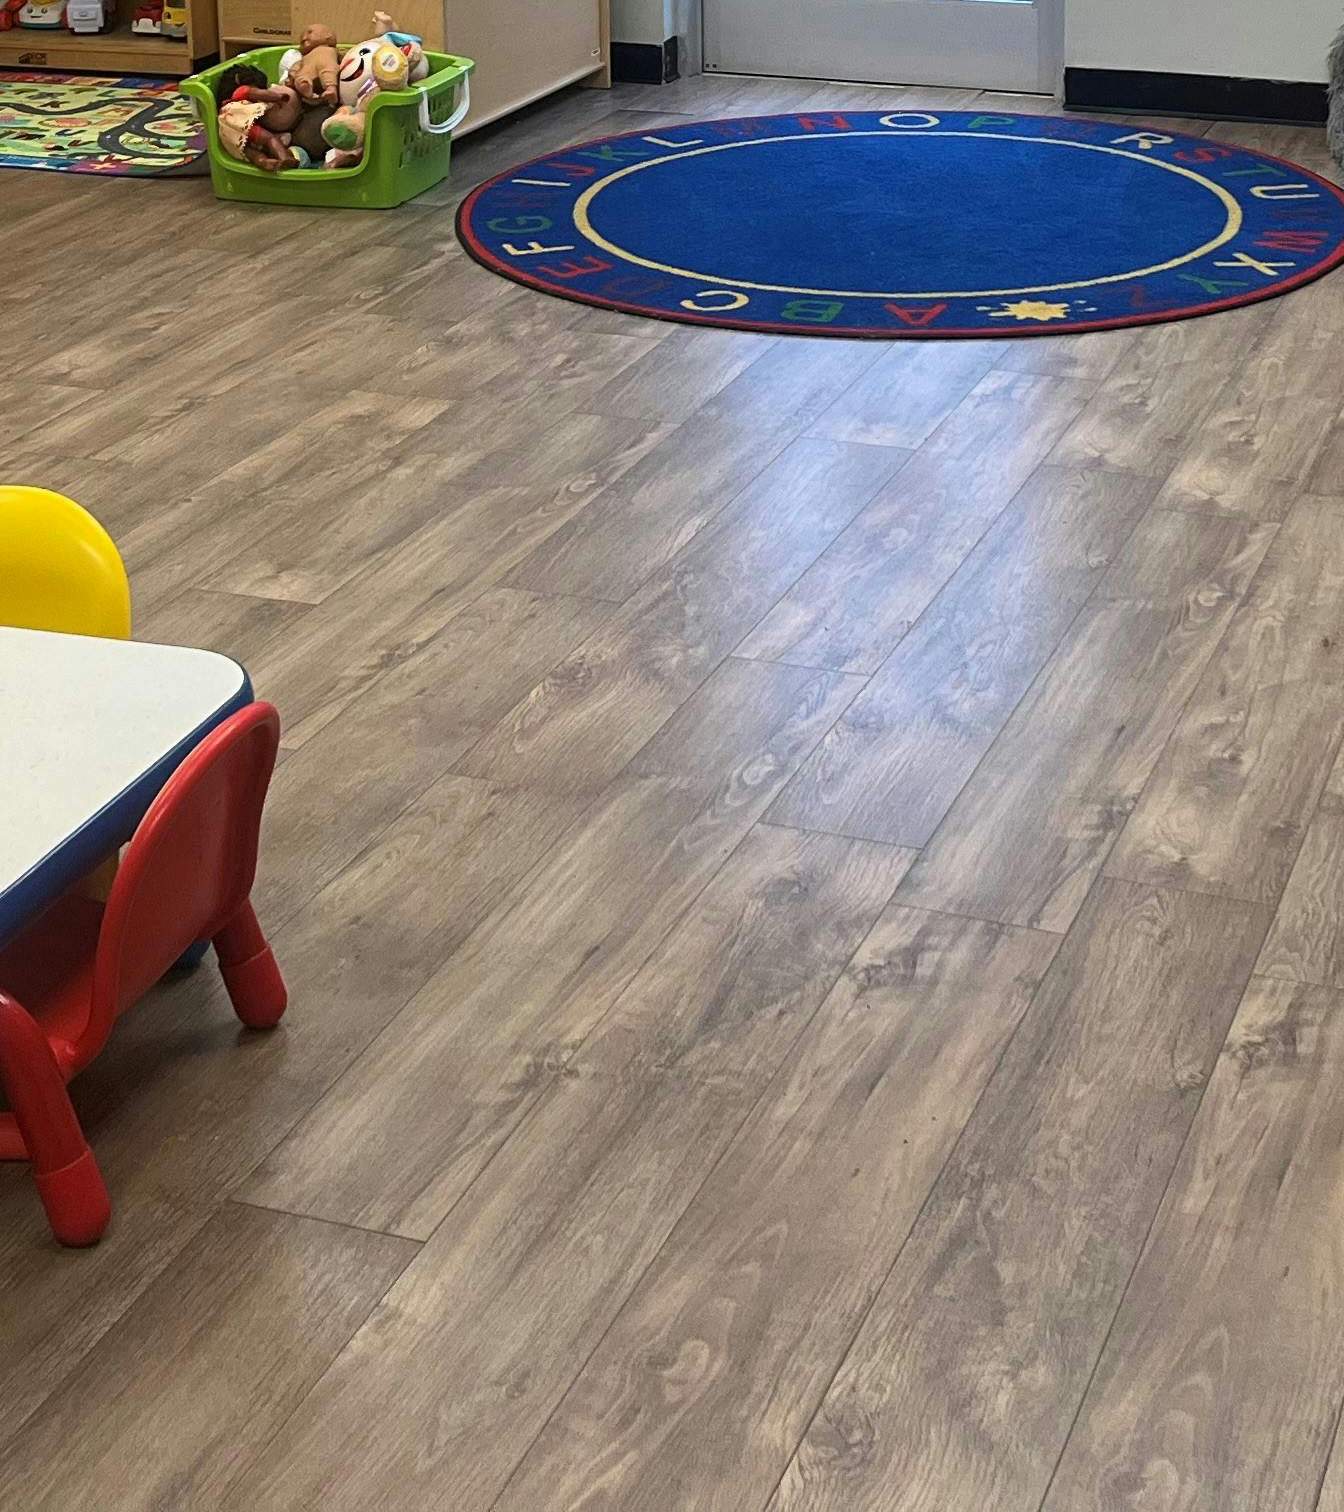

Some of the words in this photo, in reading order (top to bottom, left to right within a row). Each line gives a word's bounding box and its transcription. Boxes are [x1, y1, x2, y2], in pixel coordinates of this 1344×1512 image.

[797, 115, 853, 132] N
[879, 113, 940, 129] O
[968, 115, 1016, 129] P
[642, 135, 704, 148] L
[1111, 132, 1174, 150] R
[577, 145, 649, 163] K
[1174, 148, 1233, 163] S
[1222, 164, 1288, 178] T
[1250, 184, 1320, 200] U
[487, 214, 552, 234] G
[502, 240, 575, 256] F
[1253, 231, 1331, 253] W
[536, 255, 615, 279] E
[1213, 253, 1297, 276] X
[1176, 274, 1249, 295] Y
[680, 290, 750, 312] C
[780, 299, 845, 323] B
[885, 304, 948, 326] A
